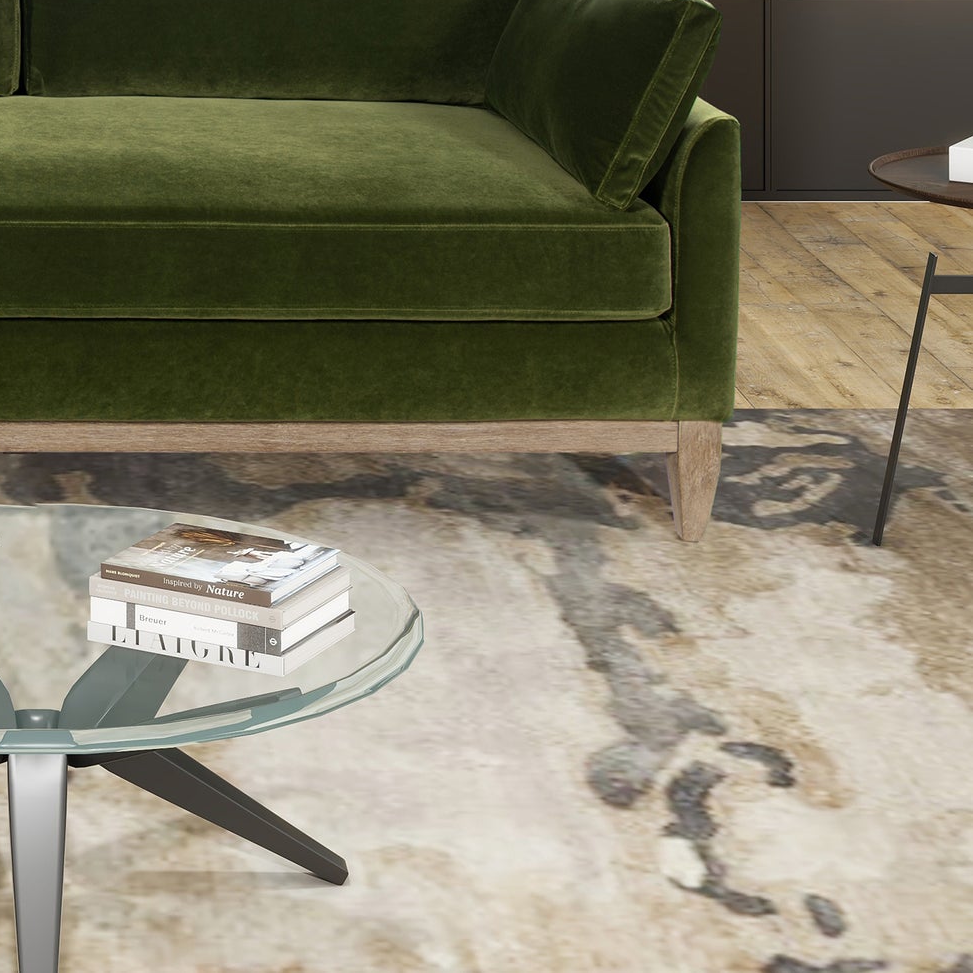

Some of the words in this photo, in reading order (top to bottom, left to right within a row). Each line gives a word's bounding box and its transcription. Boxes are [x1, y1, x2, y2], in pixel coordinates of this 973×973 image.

[163, 577, 192, 591] Inspired
[193, 581, 203, 592] by
[206, 584, 245, 600] Nature
[124, 587, 169, 604] PAINTING
[172, 596, 211, 613] BEYOND
[214, 604, 260, 622] POLLOCK
[139, 614, 167, 626] Breuer
